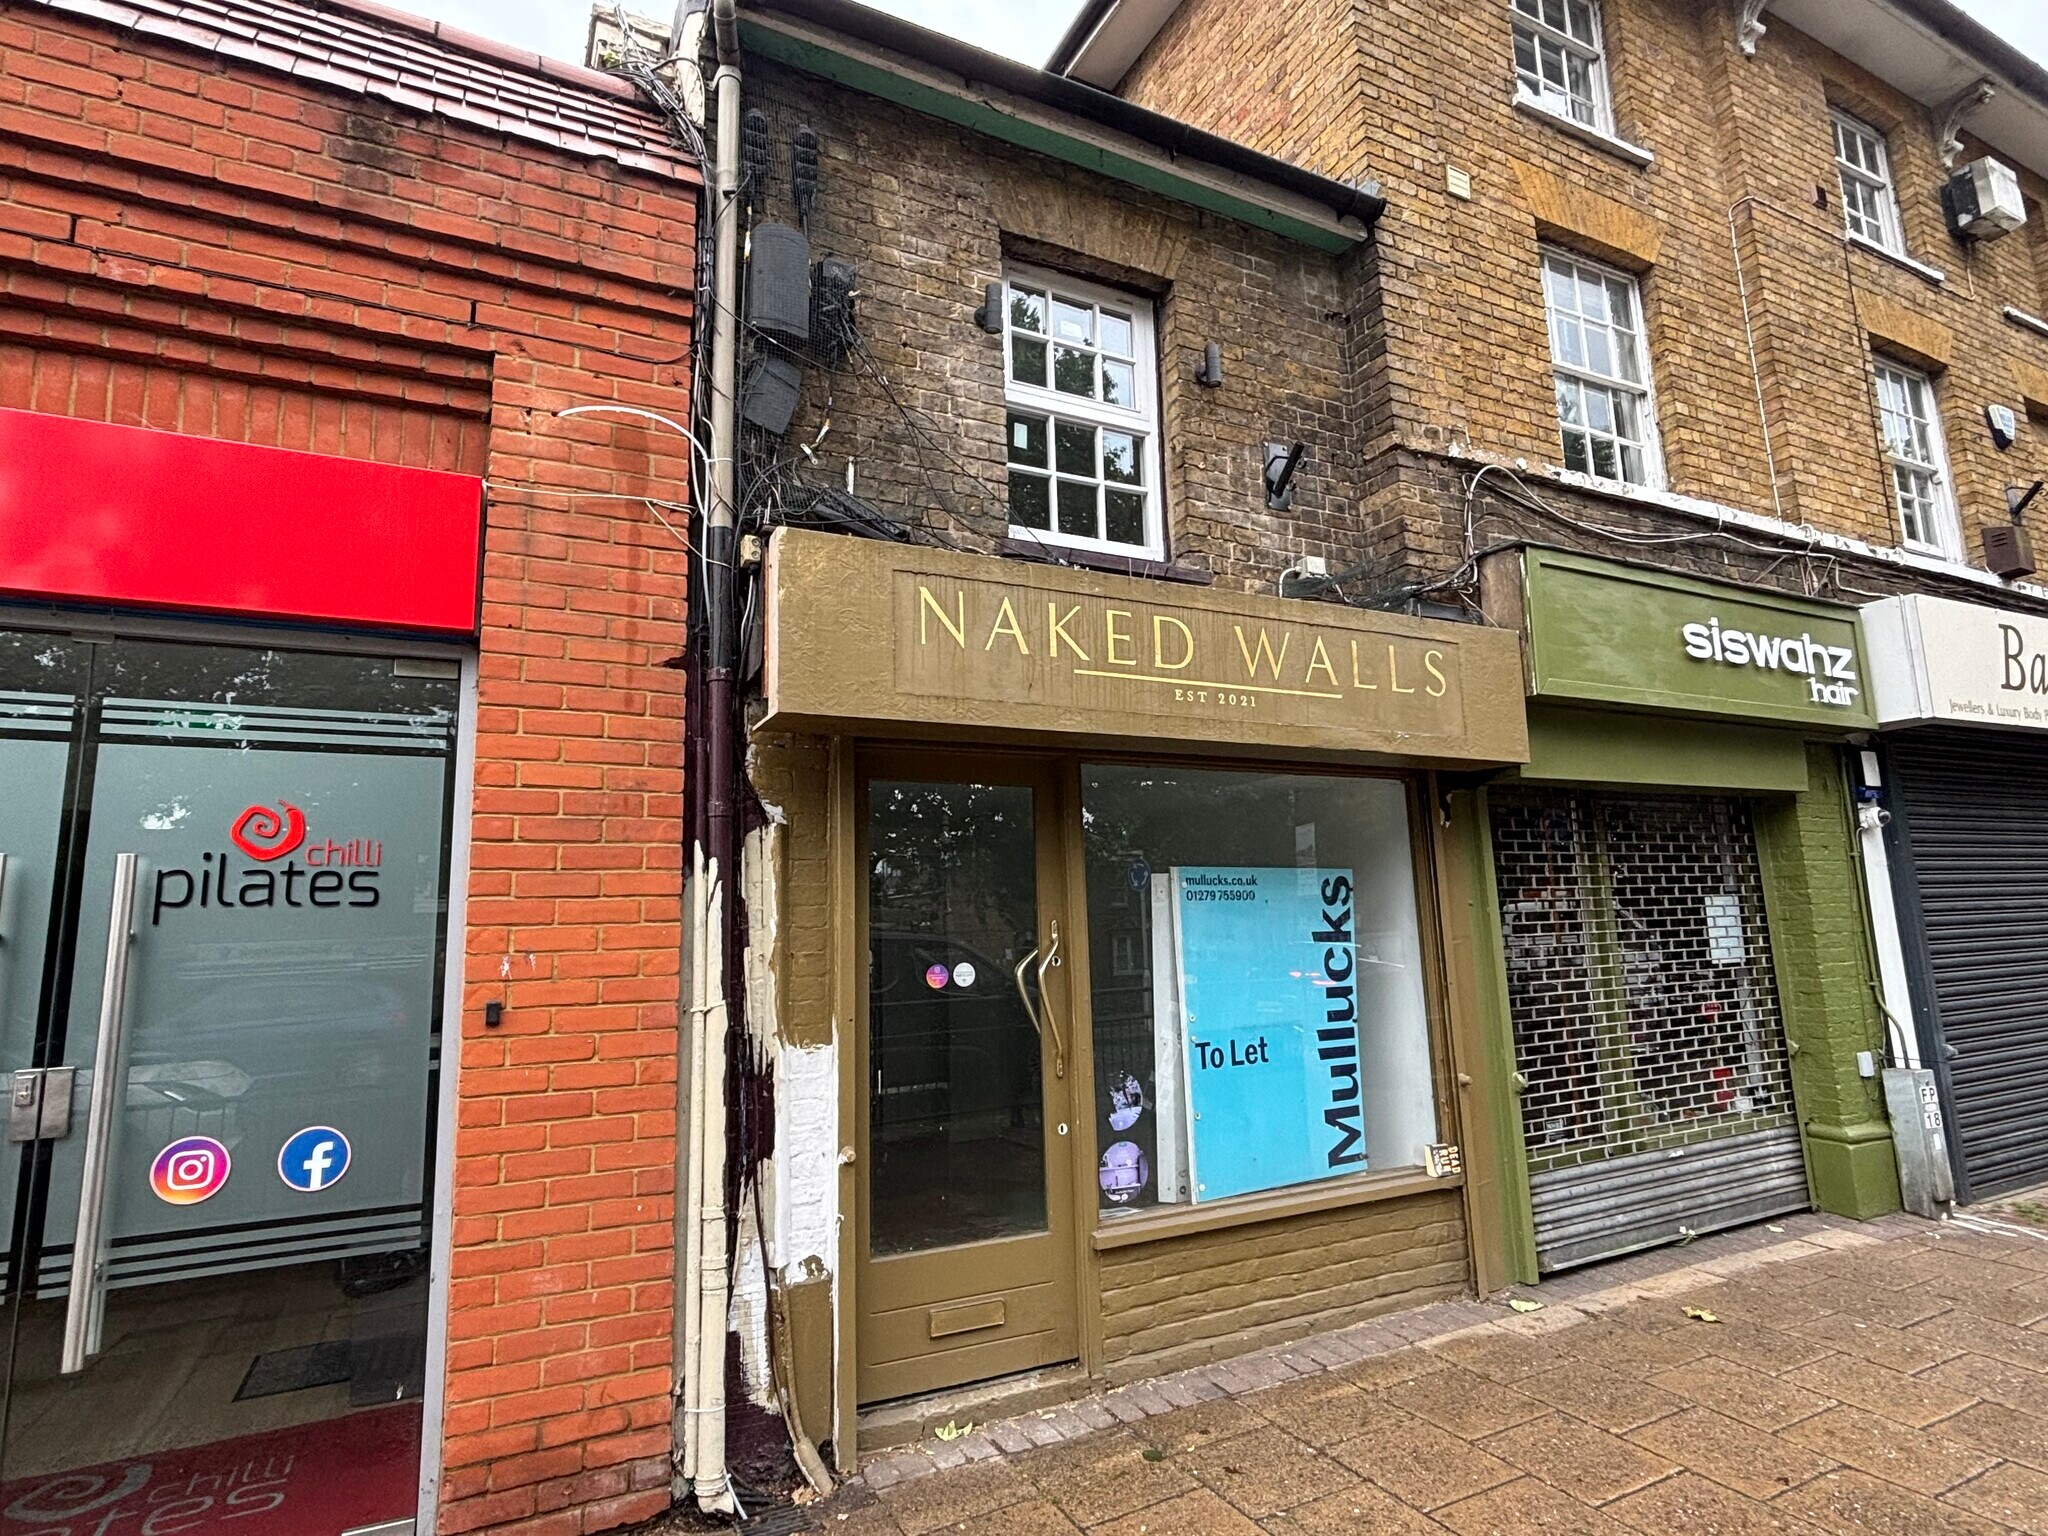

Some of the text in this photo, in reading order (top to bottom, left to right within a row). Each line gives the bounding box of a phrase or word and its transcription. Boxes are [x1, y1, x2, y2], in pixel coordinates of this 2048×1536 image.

[919, 586, 1446, 697] NAKED WALLS
[1682, 617, 1856, 680] siswahz
[1998, 623, 2048, 695] Ba
[1174, 689, 1256, 707] EST 2021
[1807, 677, 1858, 705] hair
[1949, 698, 1985, 715] Jewellers
[1987, 702, 1994, 715] &
[1996, 703, 2021, 721] Luxury
[2023, 706, 2042, 723] Body
[304, 838, 382, 867] chilli
[152, 852, 381, 926] pilates
[1185, 874, 1258, 886] mullucks.co.uk
[1186, 889, 1256, 901] 01279 755900
[1311, 875, 1366, 1169] Mullucks
[1195, 1036, 1269, 1070] To Let
[1921, 1087, 1936, 1102] FP
[1927, 1112, 1941, 1128] 18
[1448, 1145, 1461, 1174] DEAD
